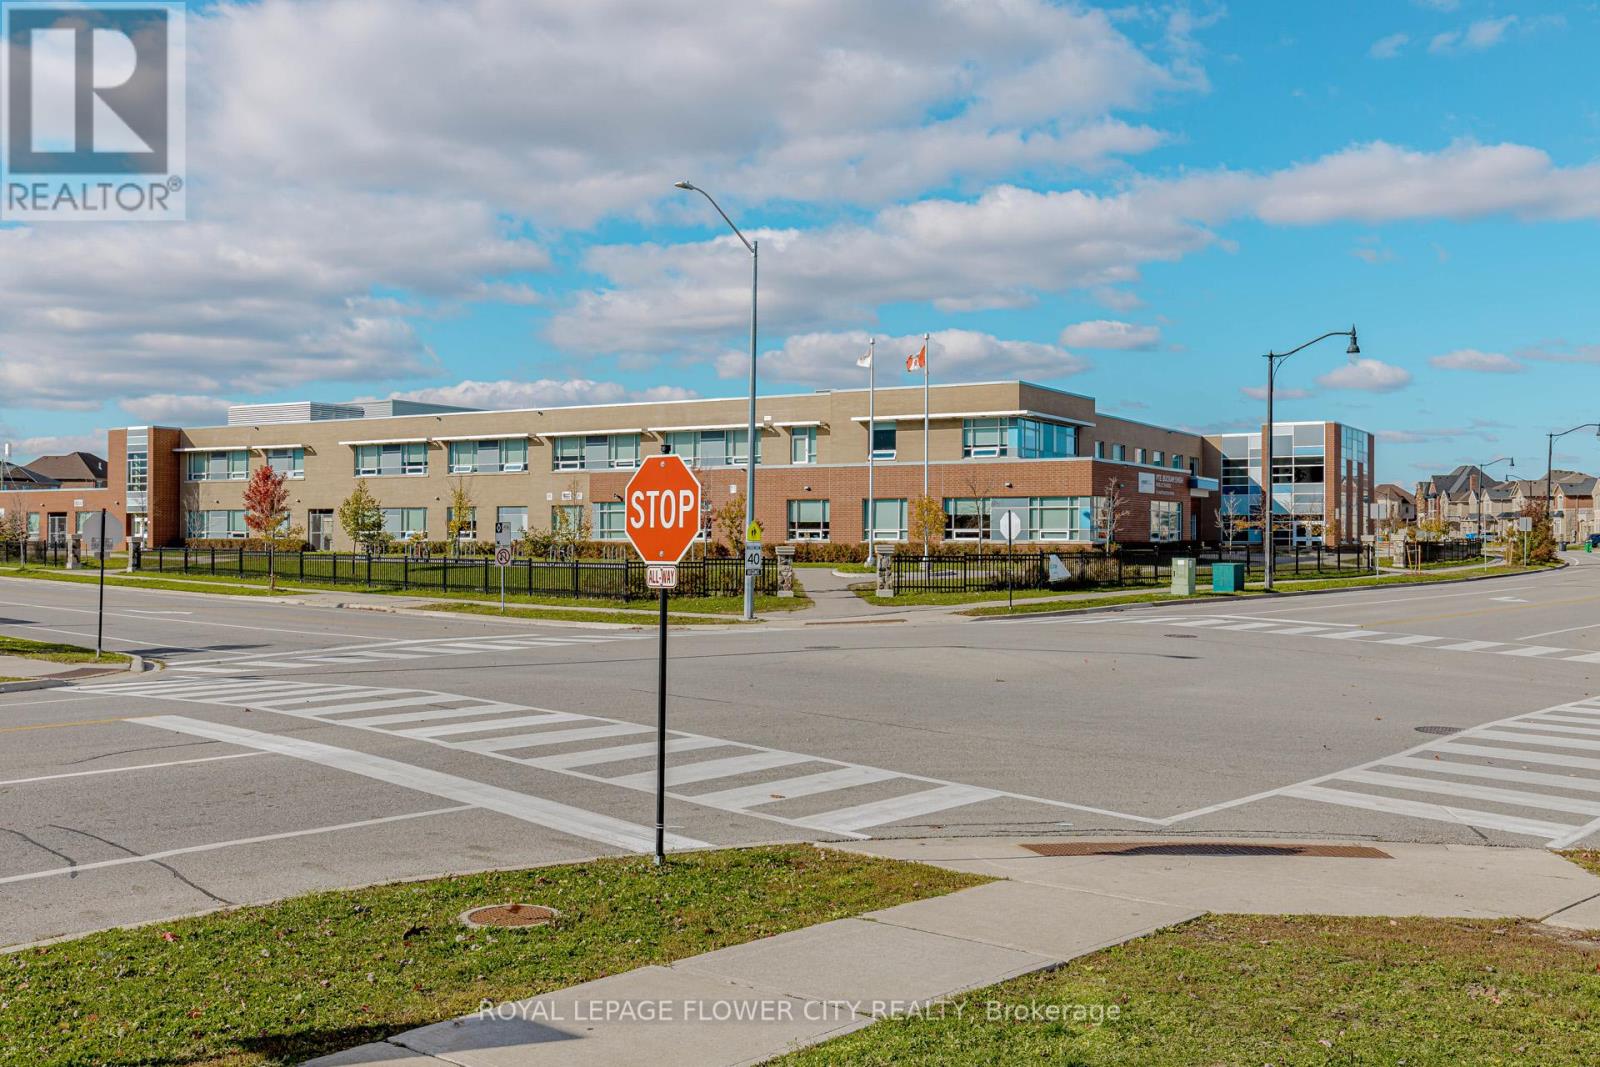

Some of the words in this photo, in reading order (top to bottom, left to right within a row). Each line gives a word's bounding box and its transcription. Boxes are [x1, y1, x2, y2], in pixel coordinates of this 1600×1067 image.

[630, 489, 695, 529] STOP
[747, 553, 760, 565] 40
[648, 567, 675, 584] ALL-WAY
